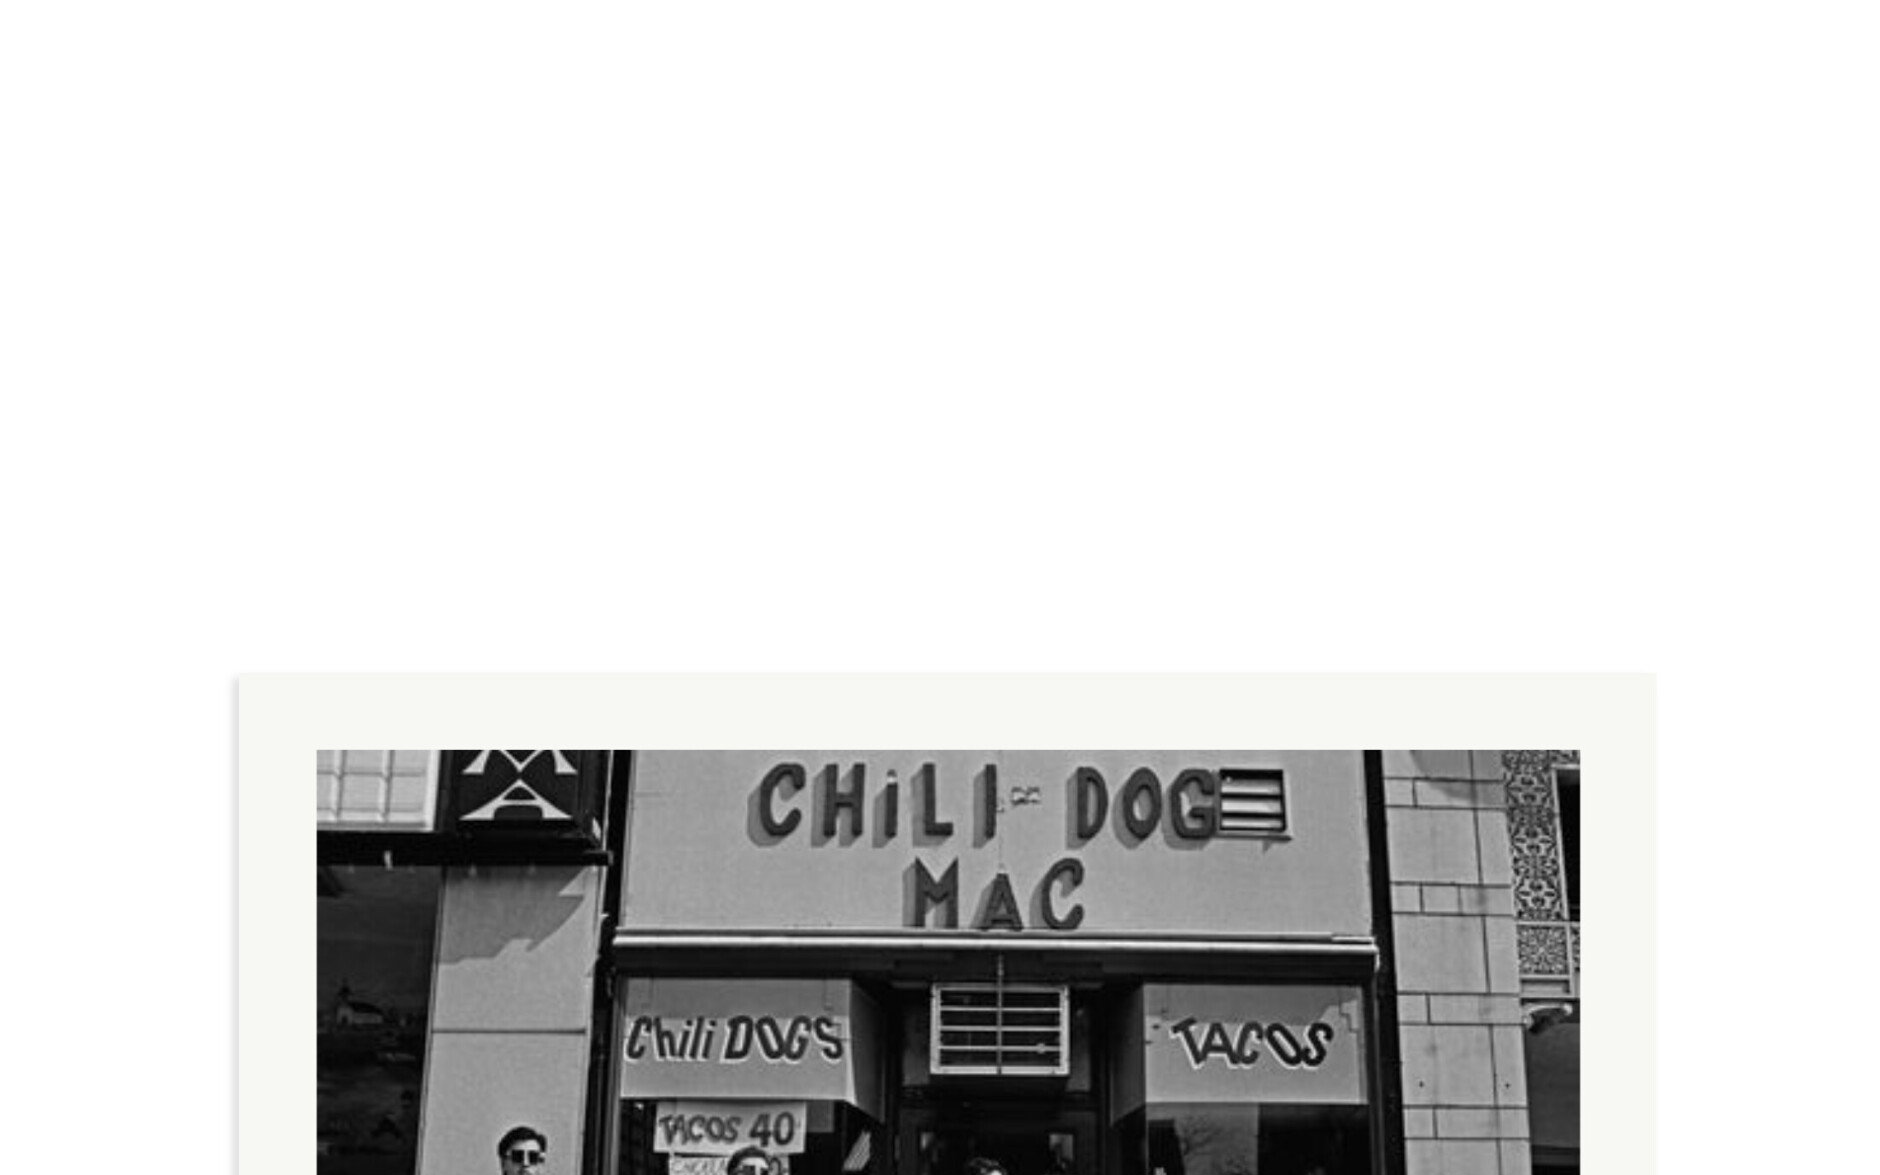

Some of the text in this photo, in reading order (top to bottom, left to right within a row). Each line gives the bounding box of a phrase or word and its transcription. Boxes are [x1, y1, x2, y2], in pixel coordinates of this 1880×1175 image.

[903, 857, 1085, 931] MAC
[720, 1015, 844, 1065] DOGS
[1168, 1016, 1335, 1069] TACOS
[659, 1111, 794, 1148] TACOS 40
